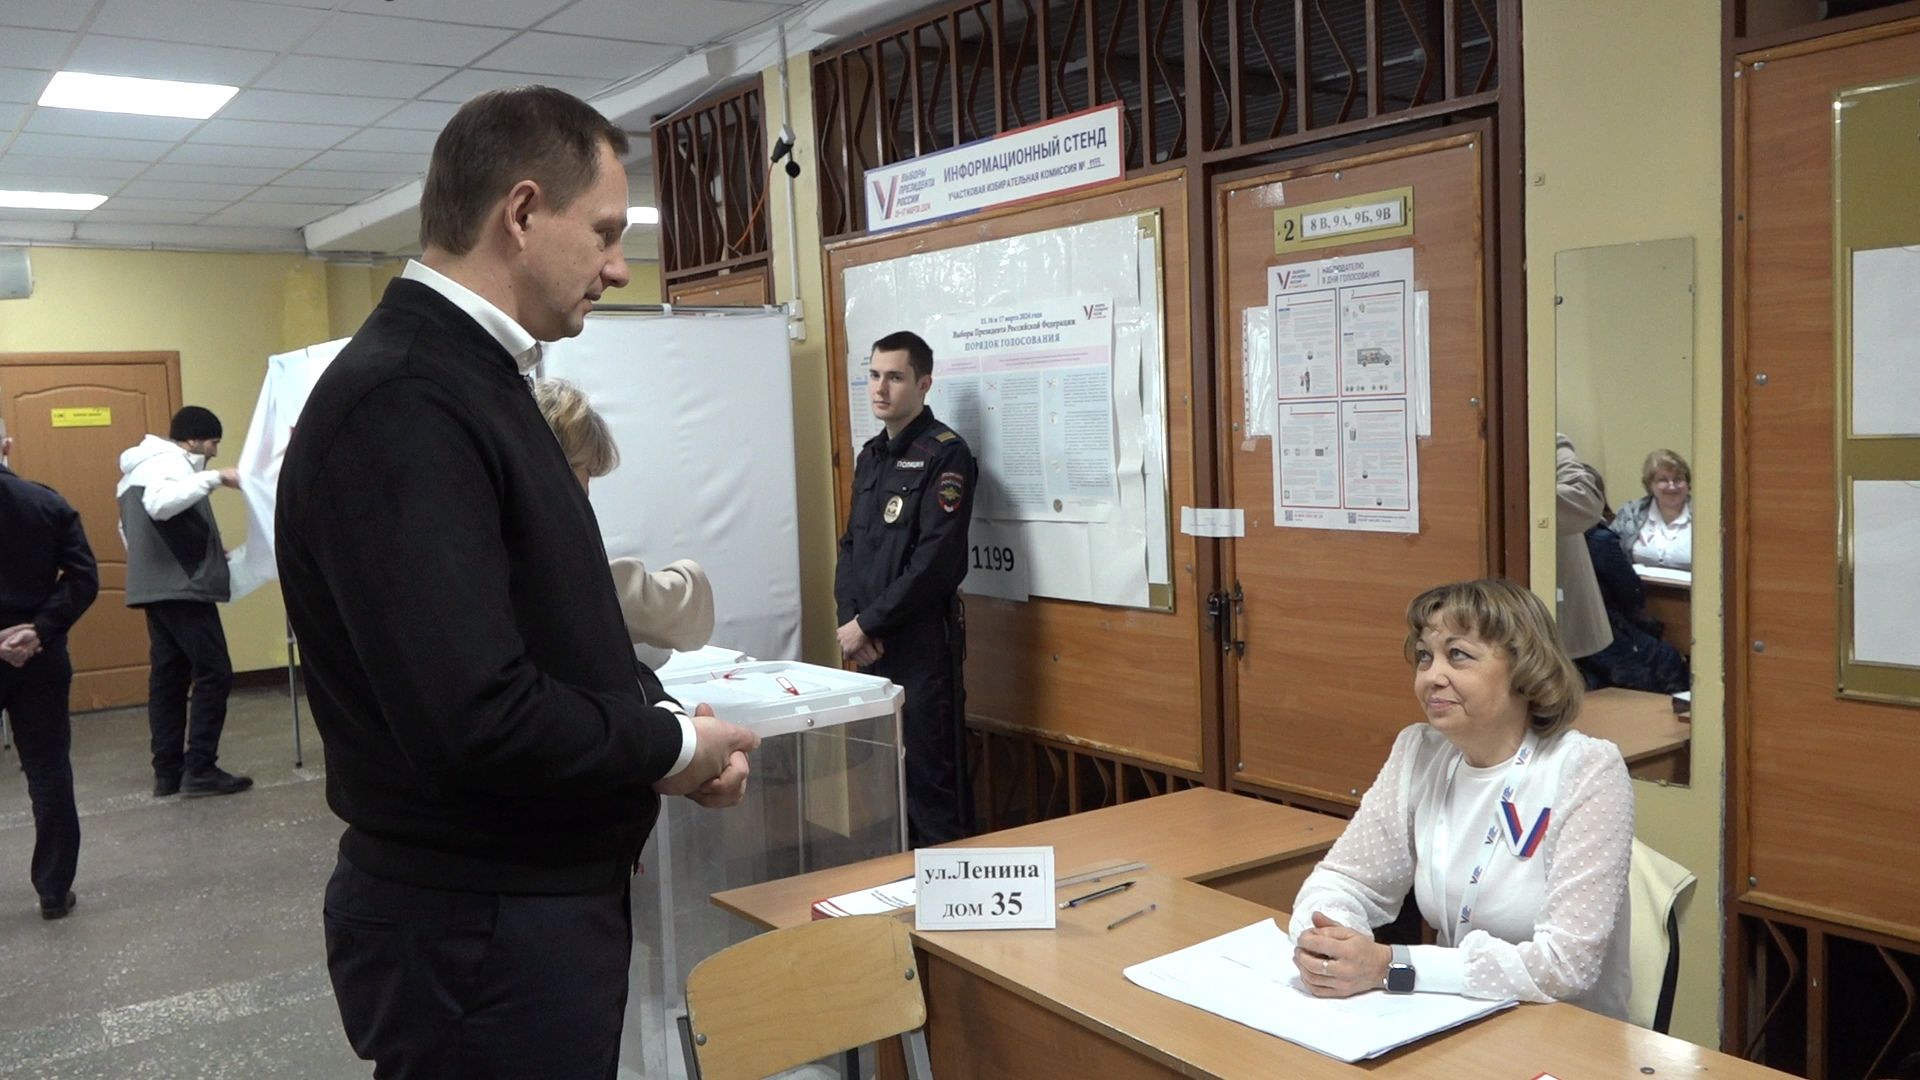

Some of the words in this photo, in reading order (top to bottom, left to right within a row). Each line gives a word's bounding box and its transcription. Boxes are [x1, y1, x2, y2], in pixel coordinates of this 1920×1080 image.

[943, 134, 1061, 183] ИНФОРМАЦИОННЫЙ
[1063, 126, 1107, 153] СТЕНД
[948, 184, 986, 201] УЧАСТКОВАЯ
[986, 171, 1040, 193] ИЗБИРАТЕЛЬНАЯ
[1040, 162, 1078, 180] КОМИССИЯ
[1283, 219, 1295, 242] 2
[1310, 218, 1317, 231] 8
[1333, 213, 1352, 227] 9А,
[1355, 210, 1373, 224] 9Б,
[1375, 207, 1392, 221] 9В
[1340, 270, 1380, 282] ГОЛОСОВАНИЯ
[975, 327, 1006, 338] Президента
[1007, 321, 1041, 332] Российской
[1042, 319, 1076, 329] Федерации
[965, 339, 1000, 351] ПОРЯДОК
[1001, 333, 1060, 348] ГОЛОСОВАНИЯ
[897, 460, 925, 468] ПОЛИЦИЯ
[971, 545, 1014, 571] 1199
[924, 861, 1040, 884] ул.Ленина
[942, 901, 983, 919] дом
[990, 891, 1023, 917] 35
